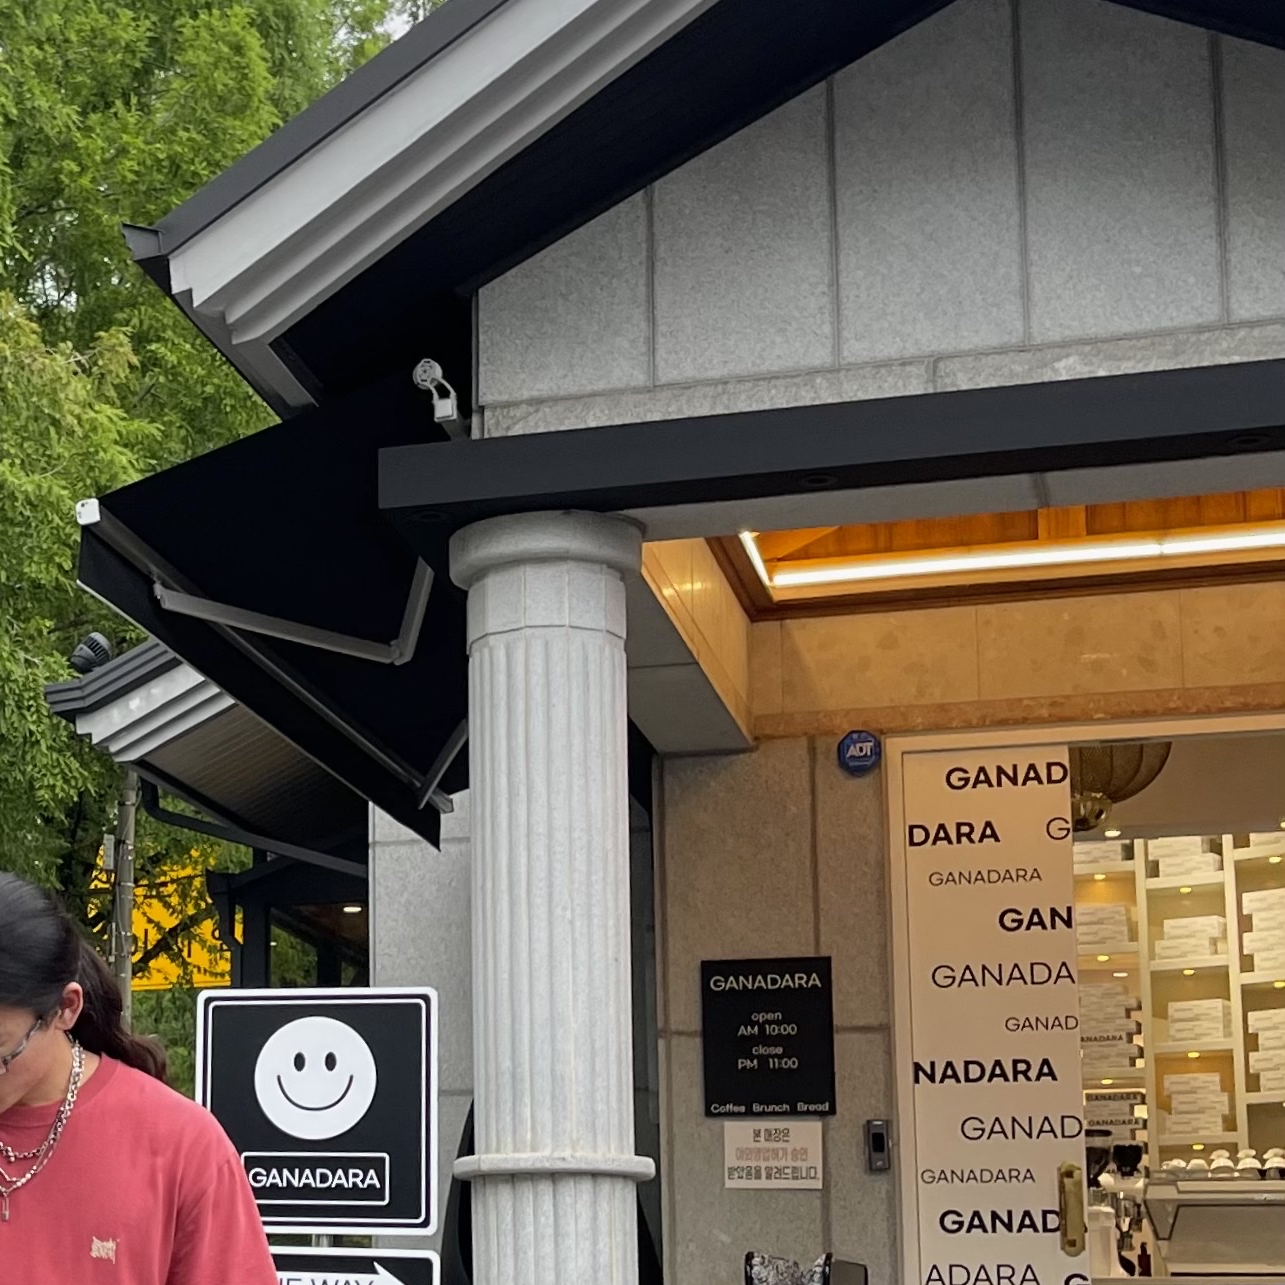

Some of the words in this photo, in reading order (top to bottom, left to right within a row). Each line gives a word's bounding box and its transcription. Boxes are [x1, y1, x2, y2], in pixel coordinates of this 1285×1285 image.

[846, 742, 873, 757] ADT
[945, 762, 1069, 790] GANAD
[907, 821, 1001, 847] DARA
[1046, 817, 1071, 840] G
[929, 868, 1043, 886] GANADARA
[998, 906, 1074, 932] GAN
[710, 973, 822, 991] GANADARA
[931, 961, 1076, 988] GANADA
[751, 1012, 783, 1023] open
[1005, 1015, 1079, 1032] GANAD
[737, 1025, 759, 1037] AM
[765, 1024, 798, 1035] 10:00
[752, 1045, 783, 1055] close
[738, 1058, 758, 1070] PM
[769, 1057, 799, 1069] 11:00
[913, 1058, 1058, 1084] NADARA
[710, 1103, 746, 1113] Coffee
[752, 1103, 790, 1112] Brunch
[797, 1101, 830, 1112] Bread
[960, 1115, 1084, 1140] GANAD
[248, 1167, 381, 1189] GANADARA
[920, 1168, 1036, 1185] GANADARA
[939, 1209, 1088, 1234] GANAD
